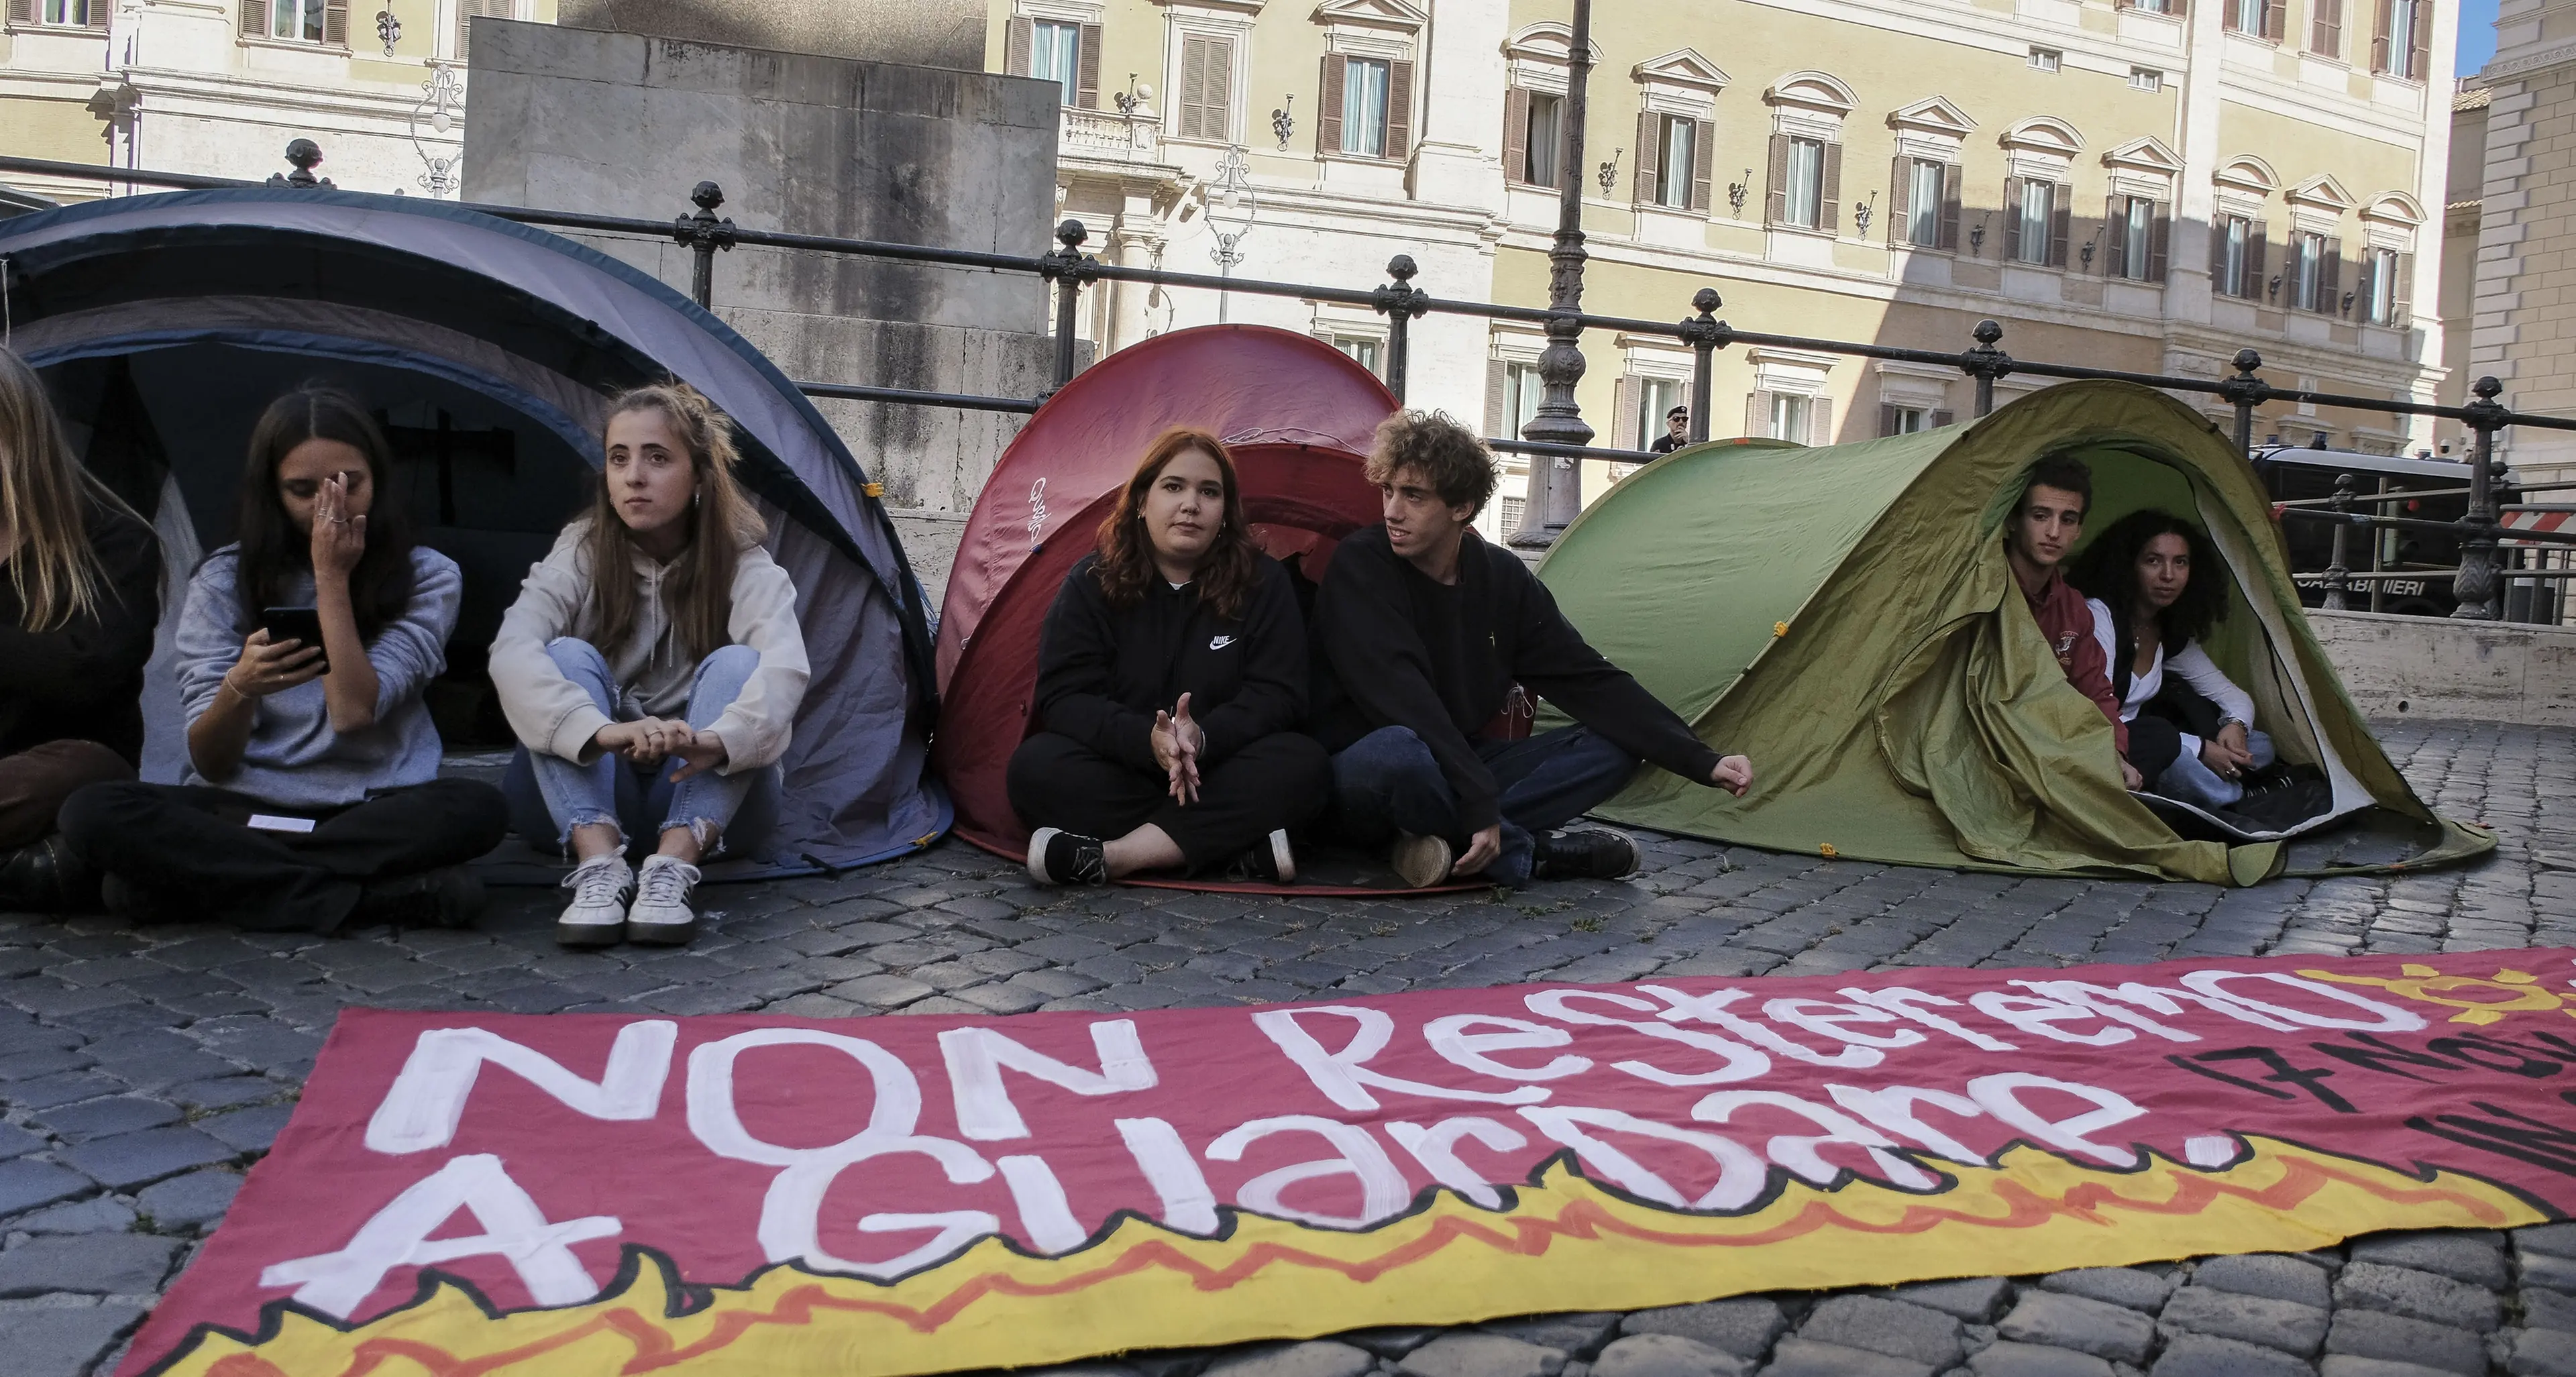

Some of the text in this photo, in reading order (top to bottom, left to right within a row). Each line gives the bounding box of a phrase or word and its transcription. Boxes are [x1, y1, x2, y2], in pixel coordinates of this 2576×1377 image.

[1213, 635, 1230, 645] NIKE
[364, 1019, 1159, 1165] NON
[2163, 1046, 2361, 1113] 17
[259, 1153, 624, 1316] A
